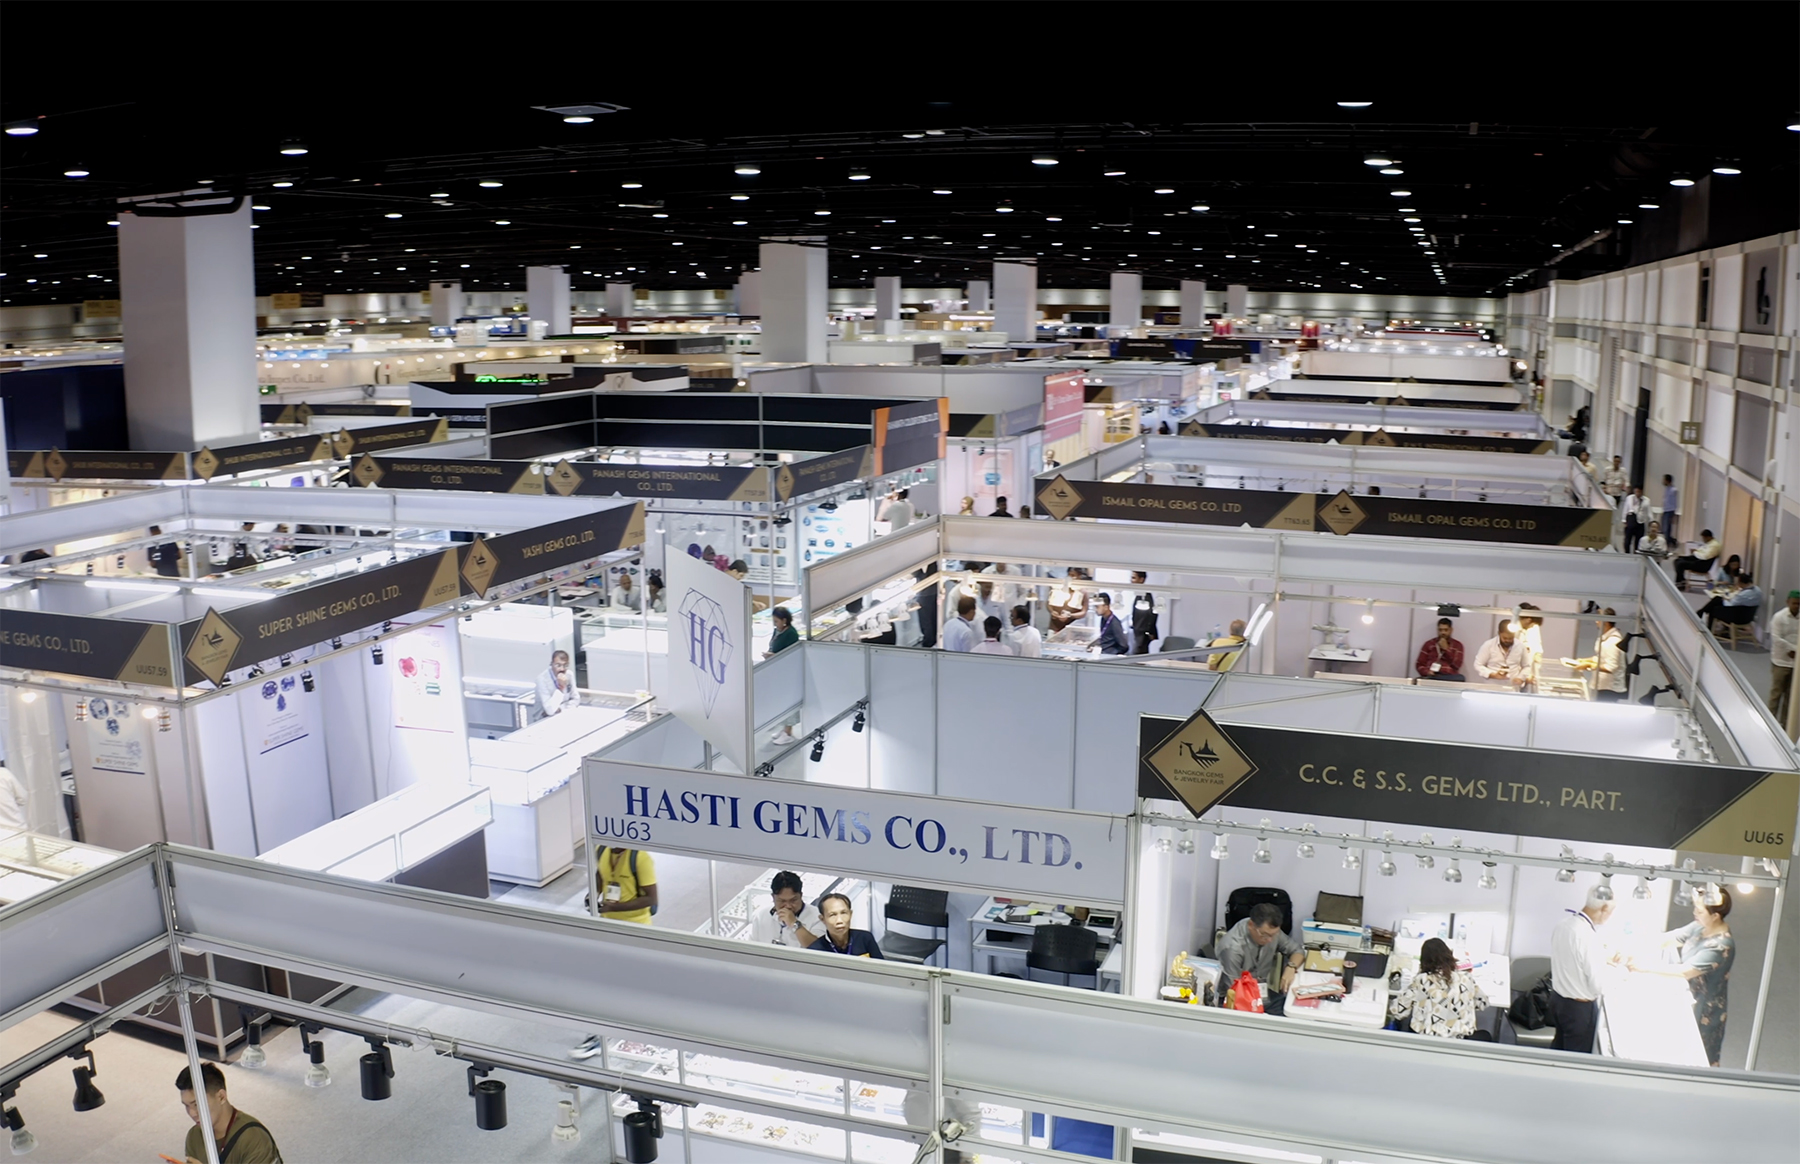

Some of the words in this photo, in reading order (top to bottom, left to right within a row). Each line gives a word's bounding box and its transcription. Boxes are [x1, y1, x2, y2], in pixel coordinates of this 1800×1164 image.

[392, 463, 421, 473] PANASH
[422, 464, 443, 473] GEMS
[443, 465, 504, 476] INTERNATIONAL
[592, 469, 625, 479] PANASH
[627, 470, 650, 480] GEMS
[651, 471, 721, 482] INTERNATIONAL
[1102, 495, 1134, 508] ISMAIL
[1138, 497, 1166, 510] OPAL
[1169, 499, 1198, 511] GEMS
[1200, 501, 1220, 512] CO.
[1222, 502, 1242, 513] LTD
[1388, 512, 1424, 525] ISMAIL
[1427, 514, 1456, 526] OPAL
[1459, 516, 1490, 528] GEMS
[1492, 517, 1513, 529] CO.
[1515, 519, 1537, 531] LTD
[521, 543, 543, 559] YASHI
[543, 537, 565, 553] GEMS
[258, 618, 294, 640] SUPER
[296, 610, 328, 628] SHINE
[329, 600, 358, 619] GEMS
[382, 584, 403, 602] LTD.
[12, 632, 43, 648] GEMS
[69, 639, 94, 655] LTD.
[688, 610, 727, 685] HG
[1173, 768, 1205, 778] BANGKOK
[1205, 770, 1224, 779] GEMS
[1180, 775, 1208, 785] JEWELRY
[1209, 778, 1225, 786] FAIR
[1298, 763, 1343, 787] C.C.
[1352, 768, 1366, 790] &
[1374, 770, 1412, 793] S.S.
[1421, 775, 1488, 800] GEMS
[1496, 781, 1551, 808] LTD.,
[1560, 787, 1625, 812] PART.
[594, 814, 652, 842] UU63
[623, 784, 742, 830] HASTI
[753, 800, 872, 845] GEMS
[884, 815, 969, 865] CO.,
[981, 825, 1083, 871] LTD.
[1743, 829, 1785, 846] UU65
